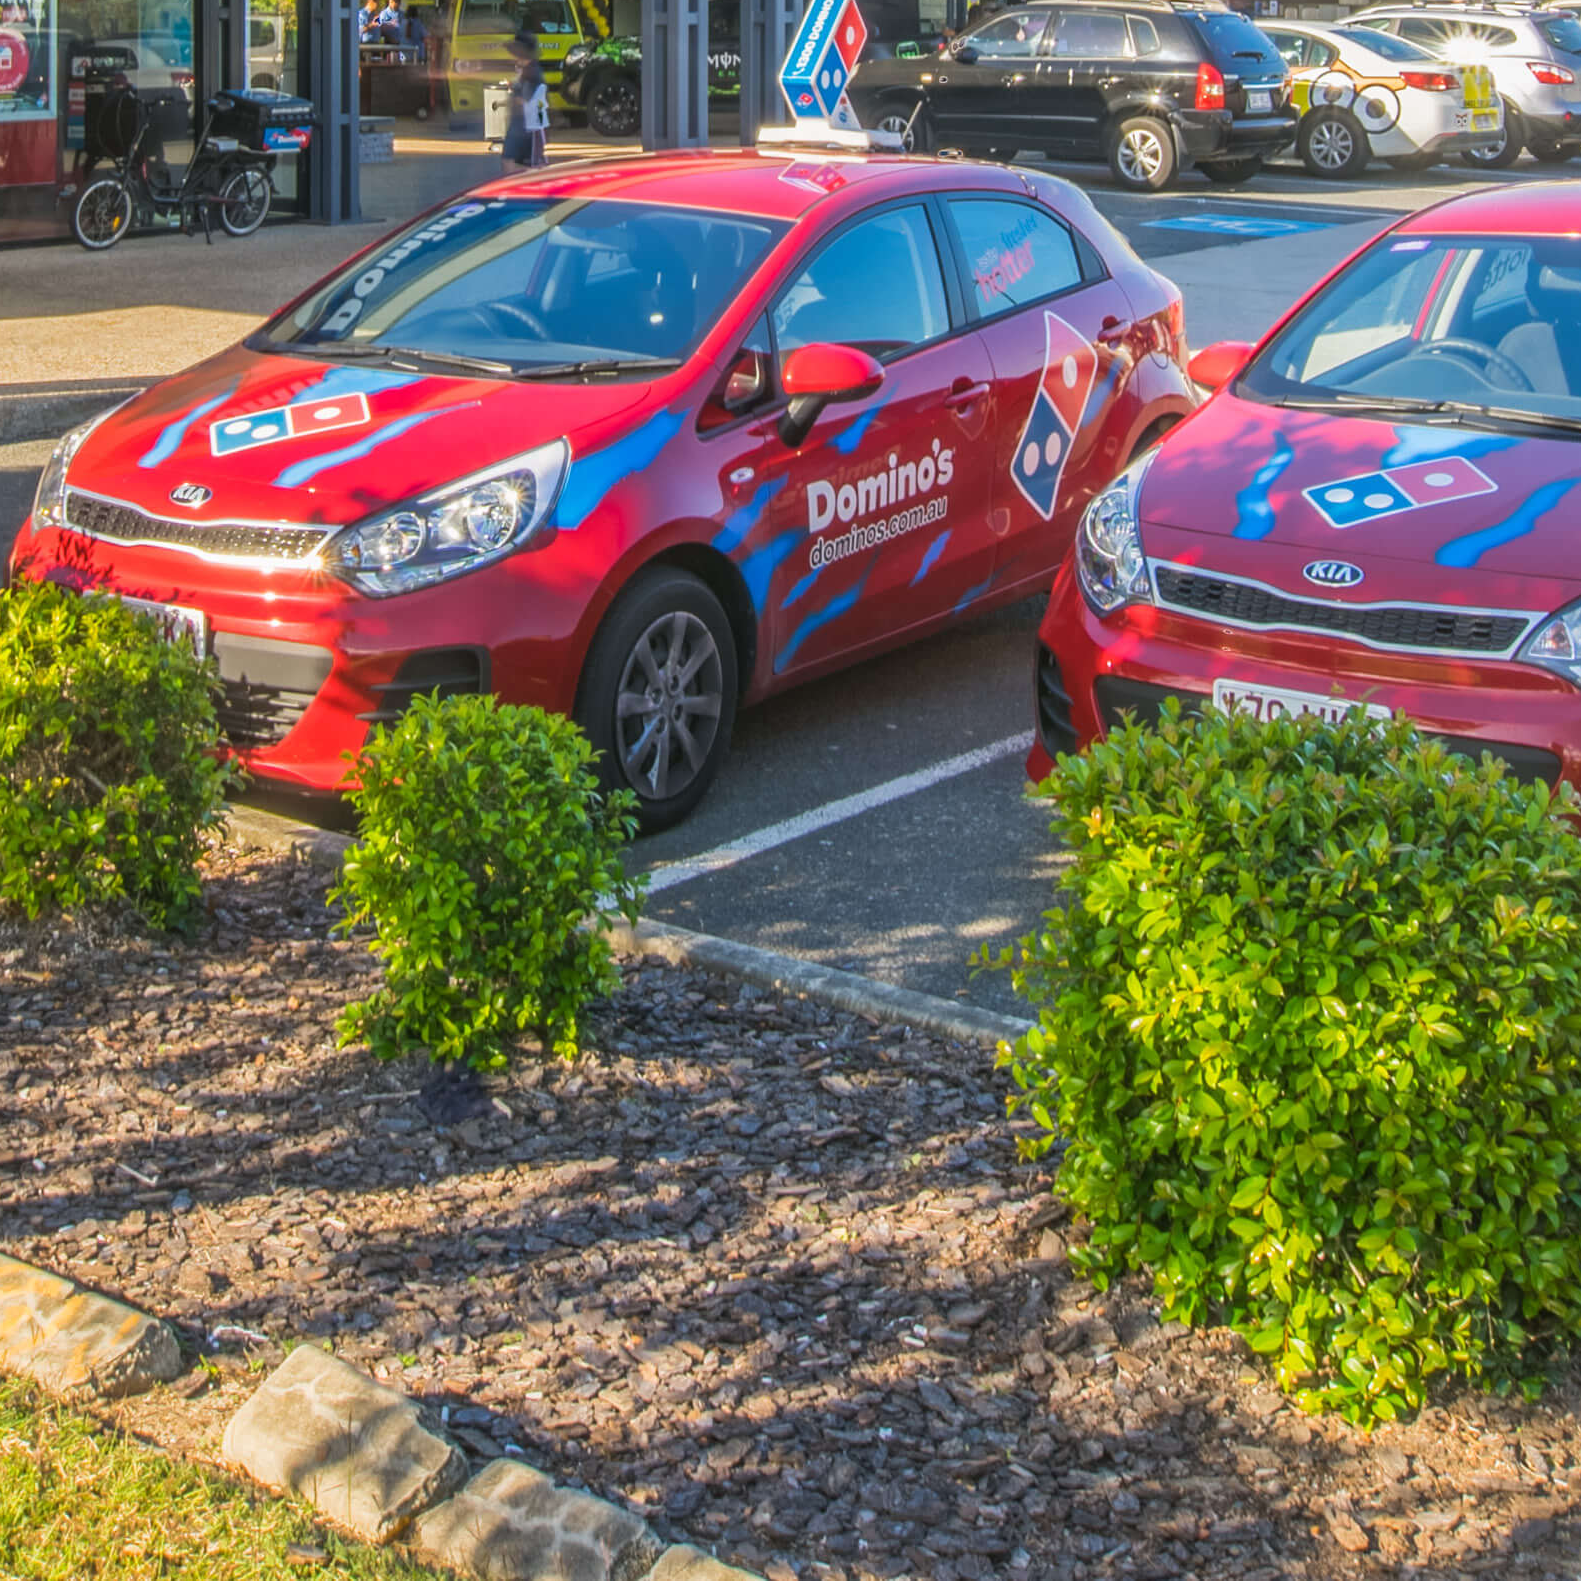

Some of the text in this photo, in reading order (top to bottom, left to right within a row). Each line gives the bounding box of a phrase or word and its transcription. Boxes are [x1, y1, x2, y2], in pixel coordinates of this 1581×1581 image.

[795, 40, 817, 69] 1300
[171, 485, 206, 501] KIA
[806, 437, 955, 534] Domino's
[809, 495, 948, 570] dominos.com.au
[1310, 562, 1353, 582] KIA
